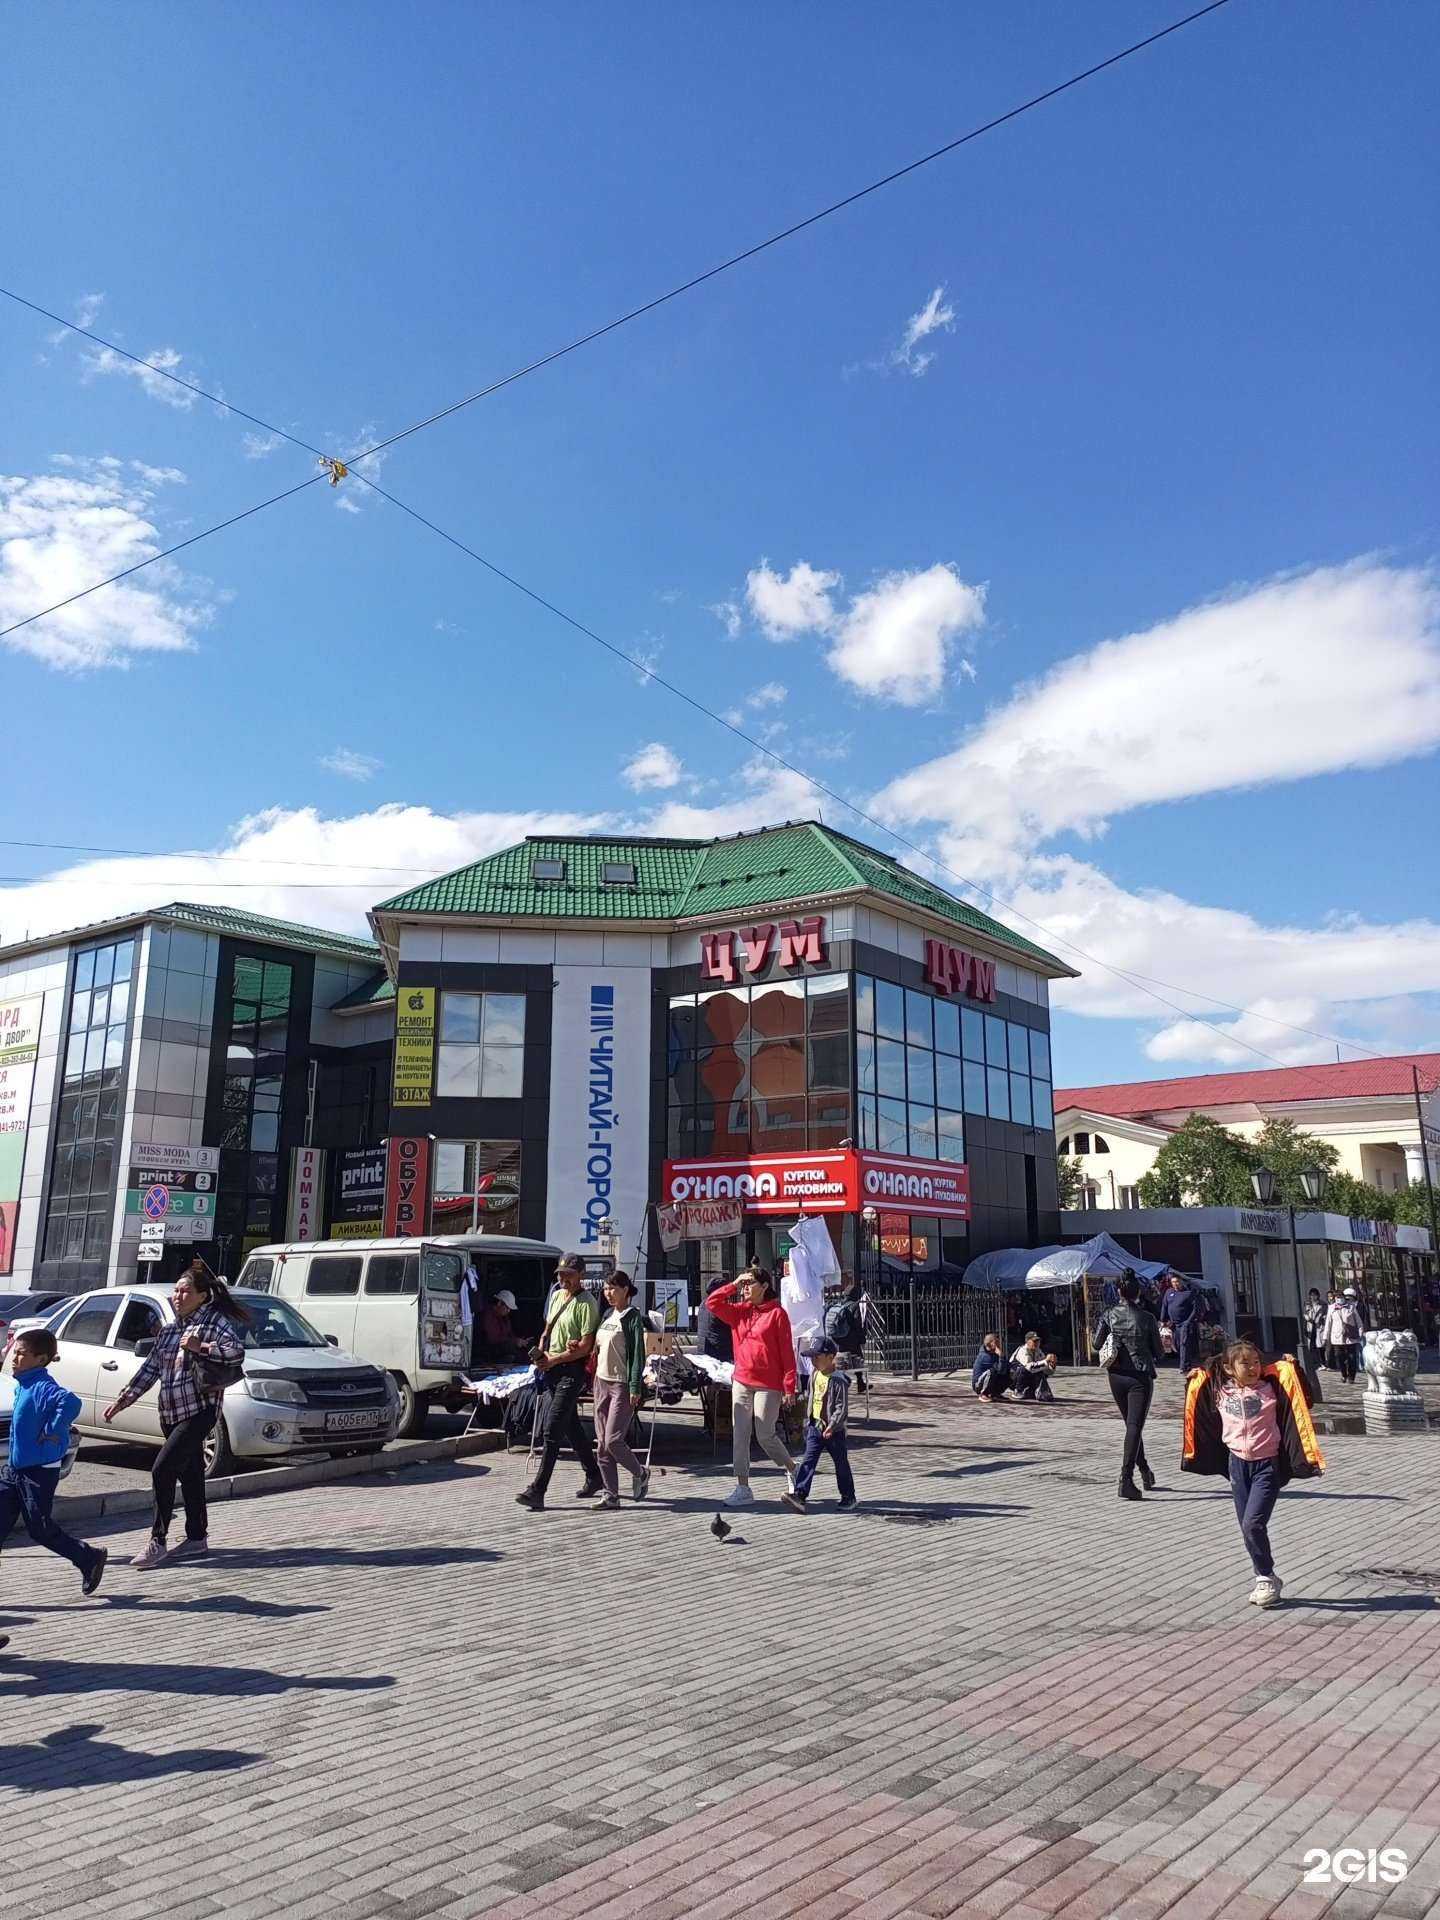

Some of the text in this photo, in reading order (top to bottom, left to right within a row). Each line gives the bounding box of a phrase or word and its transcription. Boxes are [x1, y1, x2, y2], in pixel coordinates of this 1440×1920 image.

[701, 915, 825, 982] ЦУМ
[926, 939, 995, 1003] ЦУМ
[399, 1016, 432, 1027] РЕМОНТ
[400, 1037, 431, 1047] ТЕХНИКИ
[403, 1087, 431, 1100] ЭТАЖ
[580, 1036, 619, 1244] ЧИТАЙ-ГОРОД
[138, 1146, 190, 1158] MISS MODA
[139, 1170, 174, 1183] print
[200, 1176, 206, 1184] 2
[342, 1162, 383, 1189] print
[783, 1169, 825, 1182] КУРТКИ
[397, 1140, 420, 1238] ОБУВЬ
[783, 1182, 843, 1196] ПУХОВИКИ
[934, 1190, 967, 1203] ПУХОВИКИ
